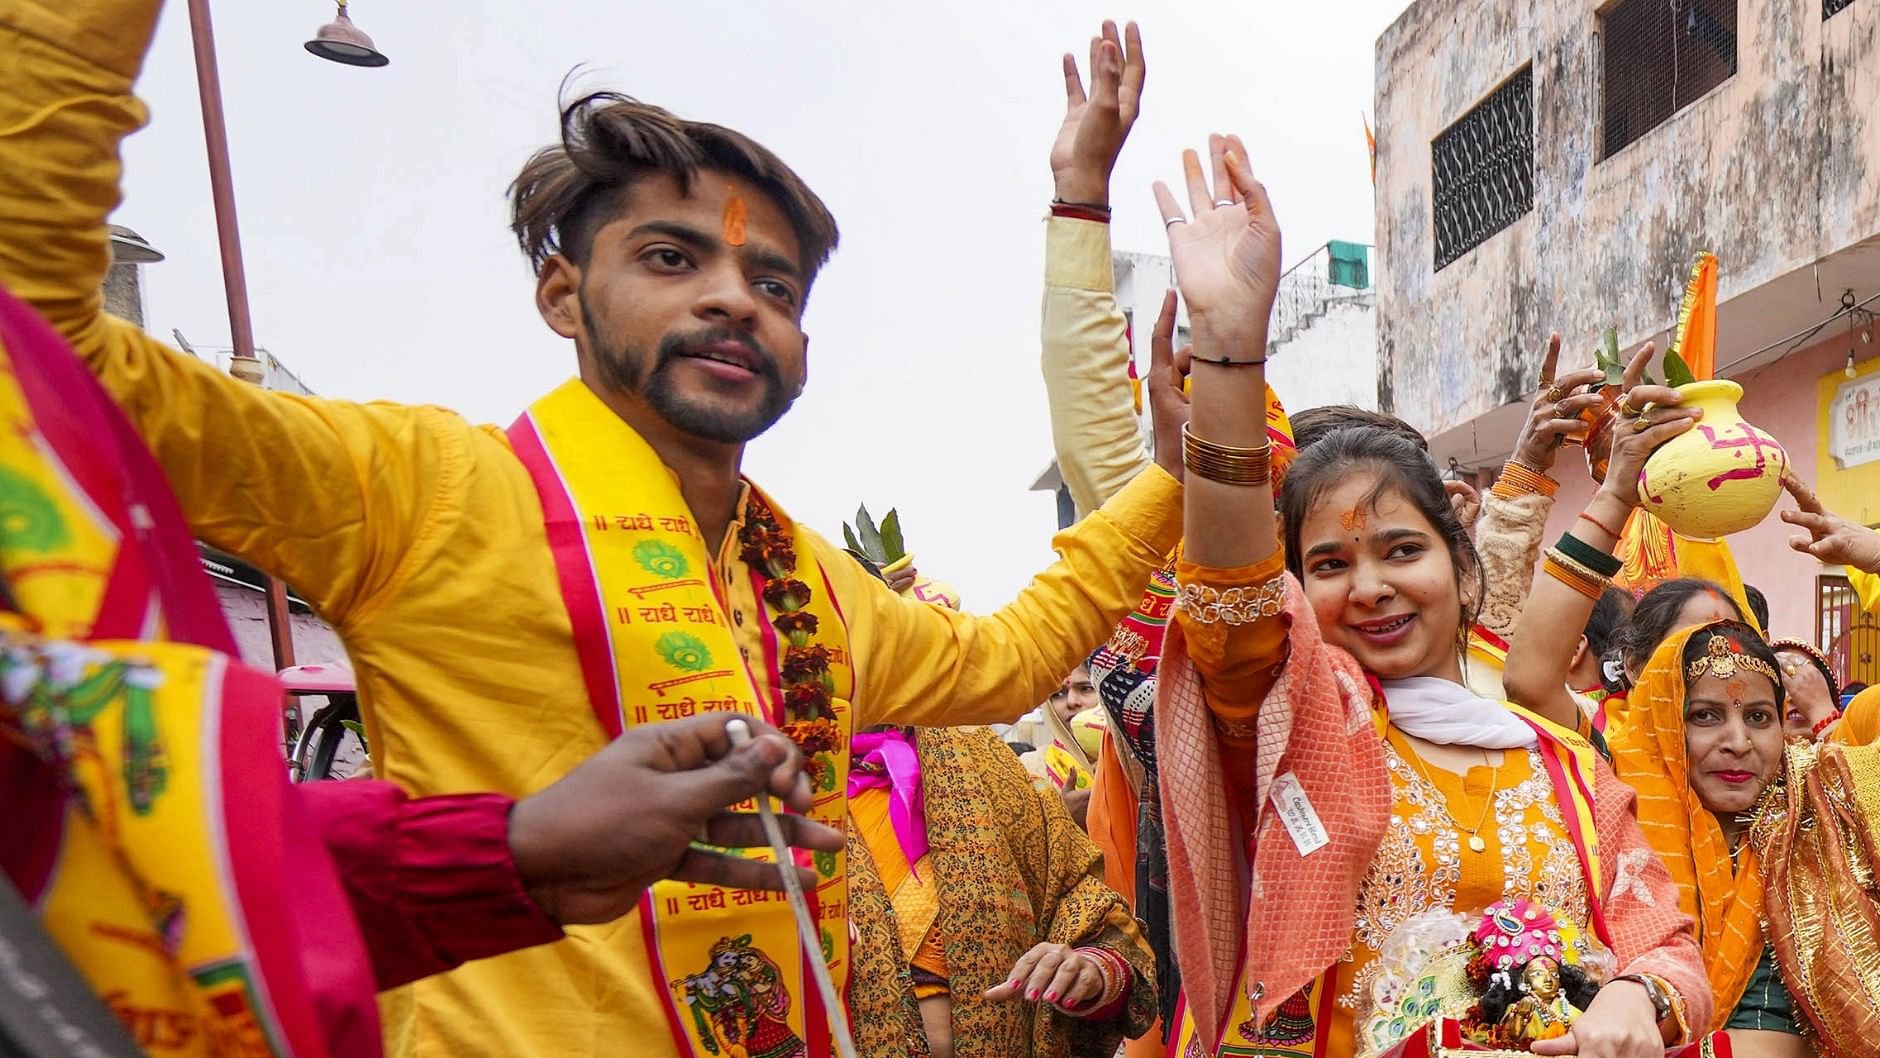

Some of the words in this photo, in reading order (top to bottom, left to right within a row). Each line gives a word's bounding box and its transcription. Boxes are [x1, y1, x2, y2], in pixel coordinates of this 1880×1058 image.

[616, 513, 654, 531] राधे
[657, 515, 692, 535] राधे
[638, 602, 677, 623] राधे
[684, 604, 716, 624] राधे
[655, 697, 696, 720] राधे
[687, 886, 726, 911] राधे
